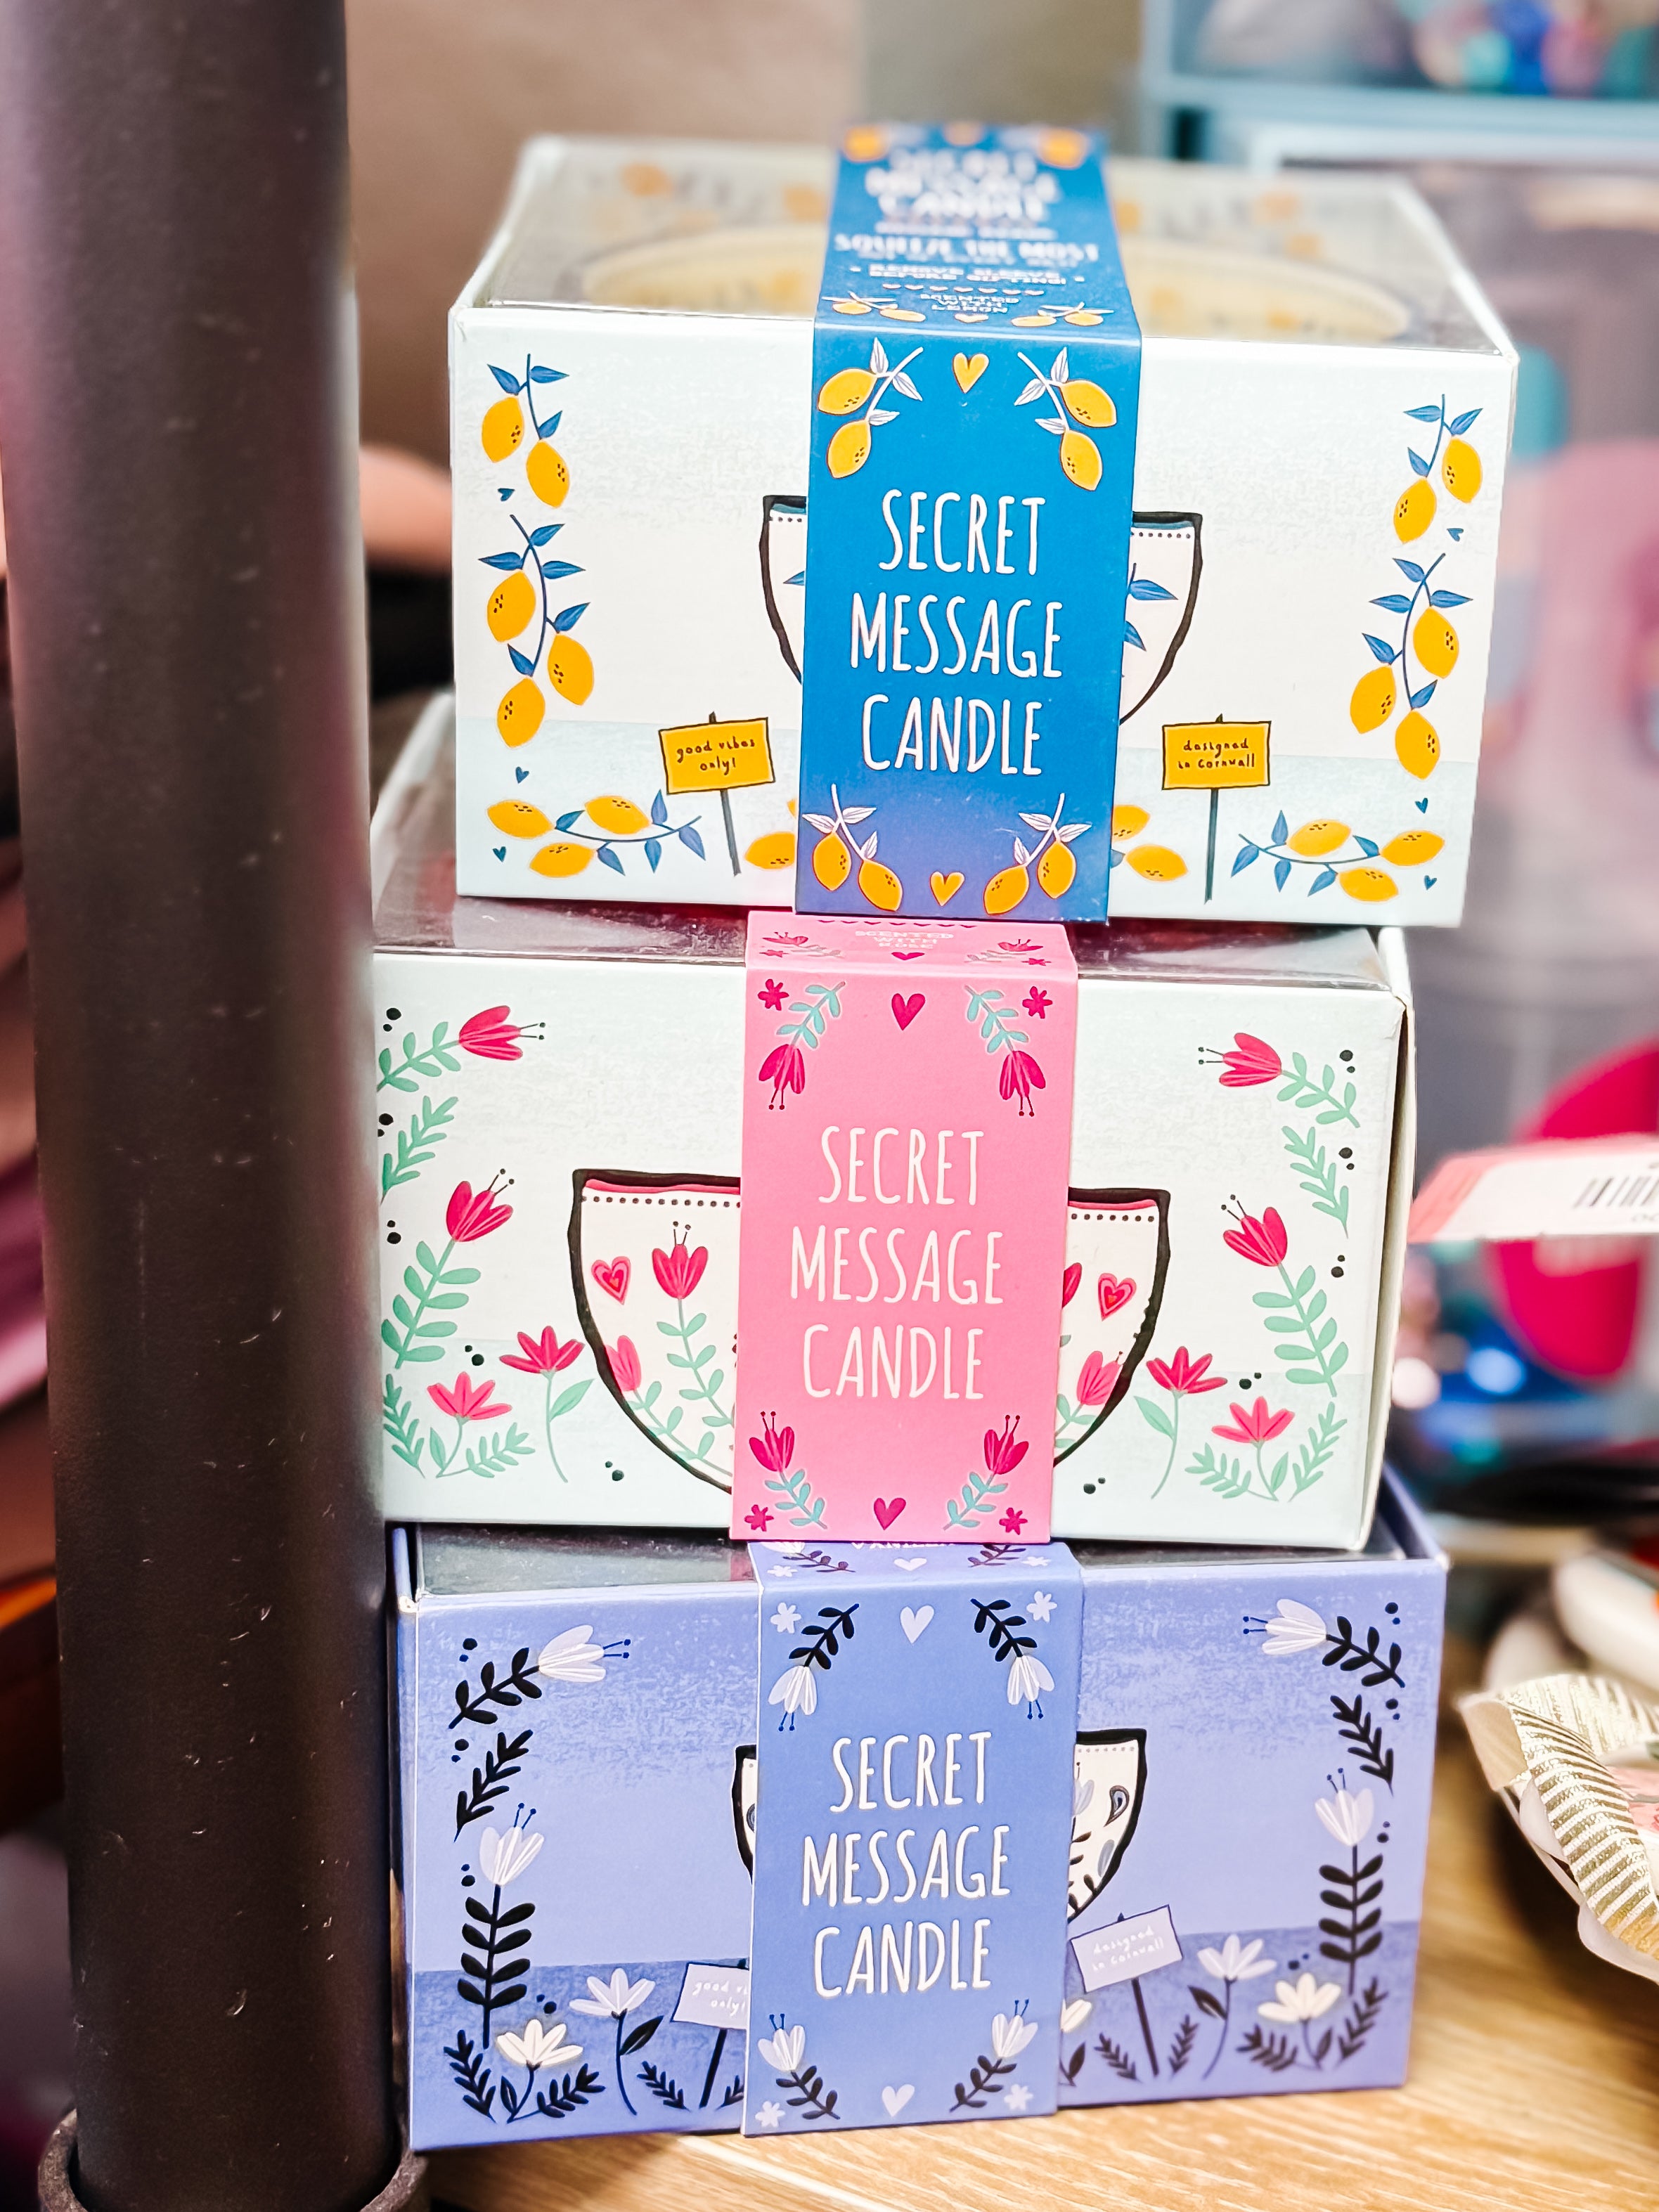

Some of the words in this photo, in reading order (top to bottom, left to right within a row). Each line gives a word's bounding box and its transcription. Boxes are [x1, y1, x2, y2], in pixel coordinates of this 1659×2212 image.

[931, 304, 1009, 313] LEMON
[878, 489, 1045, 576] SECRET
[850, 592, 1063, 678] MESSAGE
[676, 739, 713, 763] good
[718, 735, 756, 750] vibes
[699, 755, 737, 776] only!
[863, 694, 1042, 775] CANDLE
[1177, 761, 1191, 770] in
[1198, 753, 1255, 769] Cornwall
[1183, 737, 1249, 758] designed
[818, 1125, 984, 1205] SECRET
[791, 1225, 1003, 1305] MESSAGE
[803, 1324, 984, 1399] CANDLE
[830, 1731, 992, 1812] SECRET
[803, 1825, 1010, 1908] MESSAGE
[813, 1919, 991, 1998] CANDLE
[1093, 1925, 1154, 1955] designed
[692, 1980, 730, 1996] good
